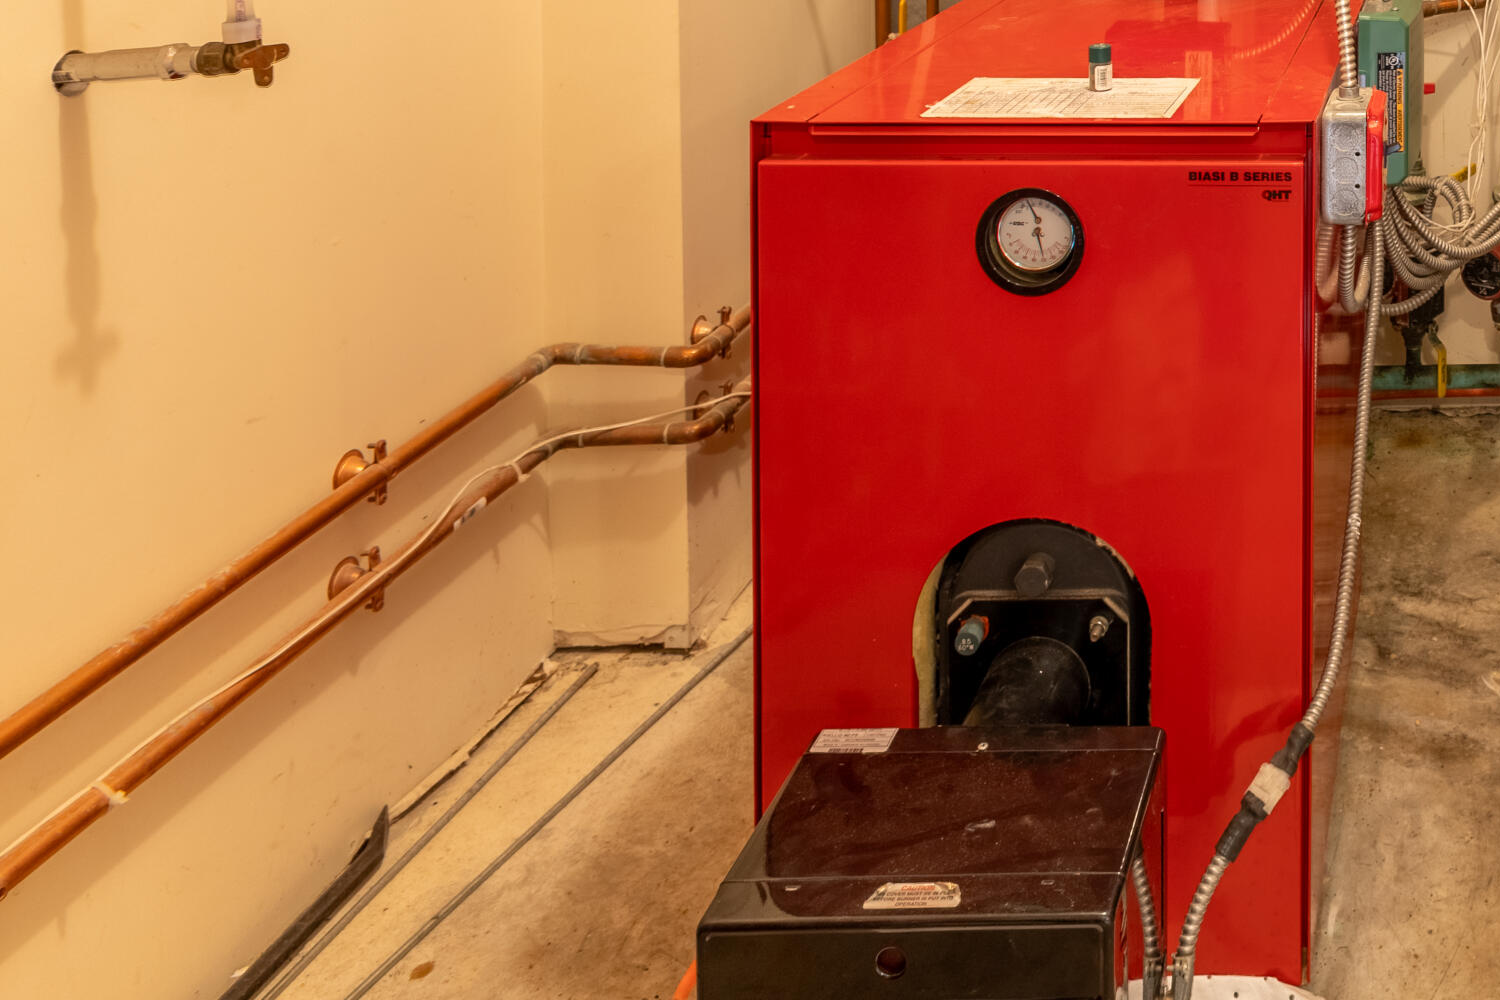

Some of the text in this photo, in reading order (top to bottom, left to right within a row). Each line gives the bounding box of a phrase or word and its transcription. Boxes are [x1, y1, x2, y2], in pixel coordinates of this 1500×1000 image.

[1188, 171, 1292, 182] BIASI B SERIES
[1262, 190, 1292, 201] QHT
